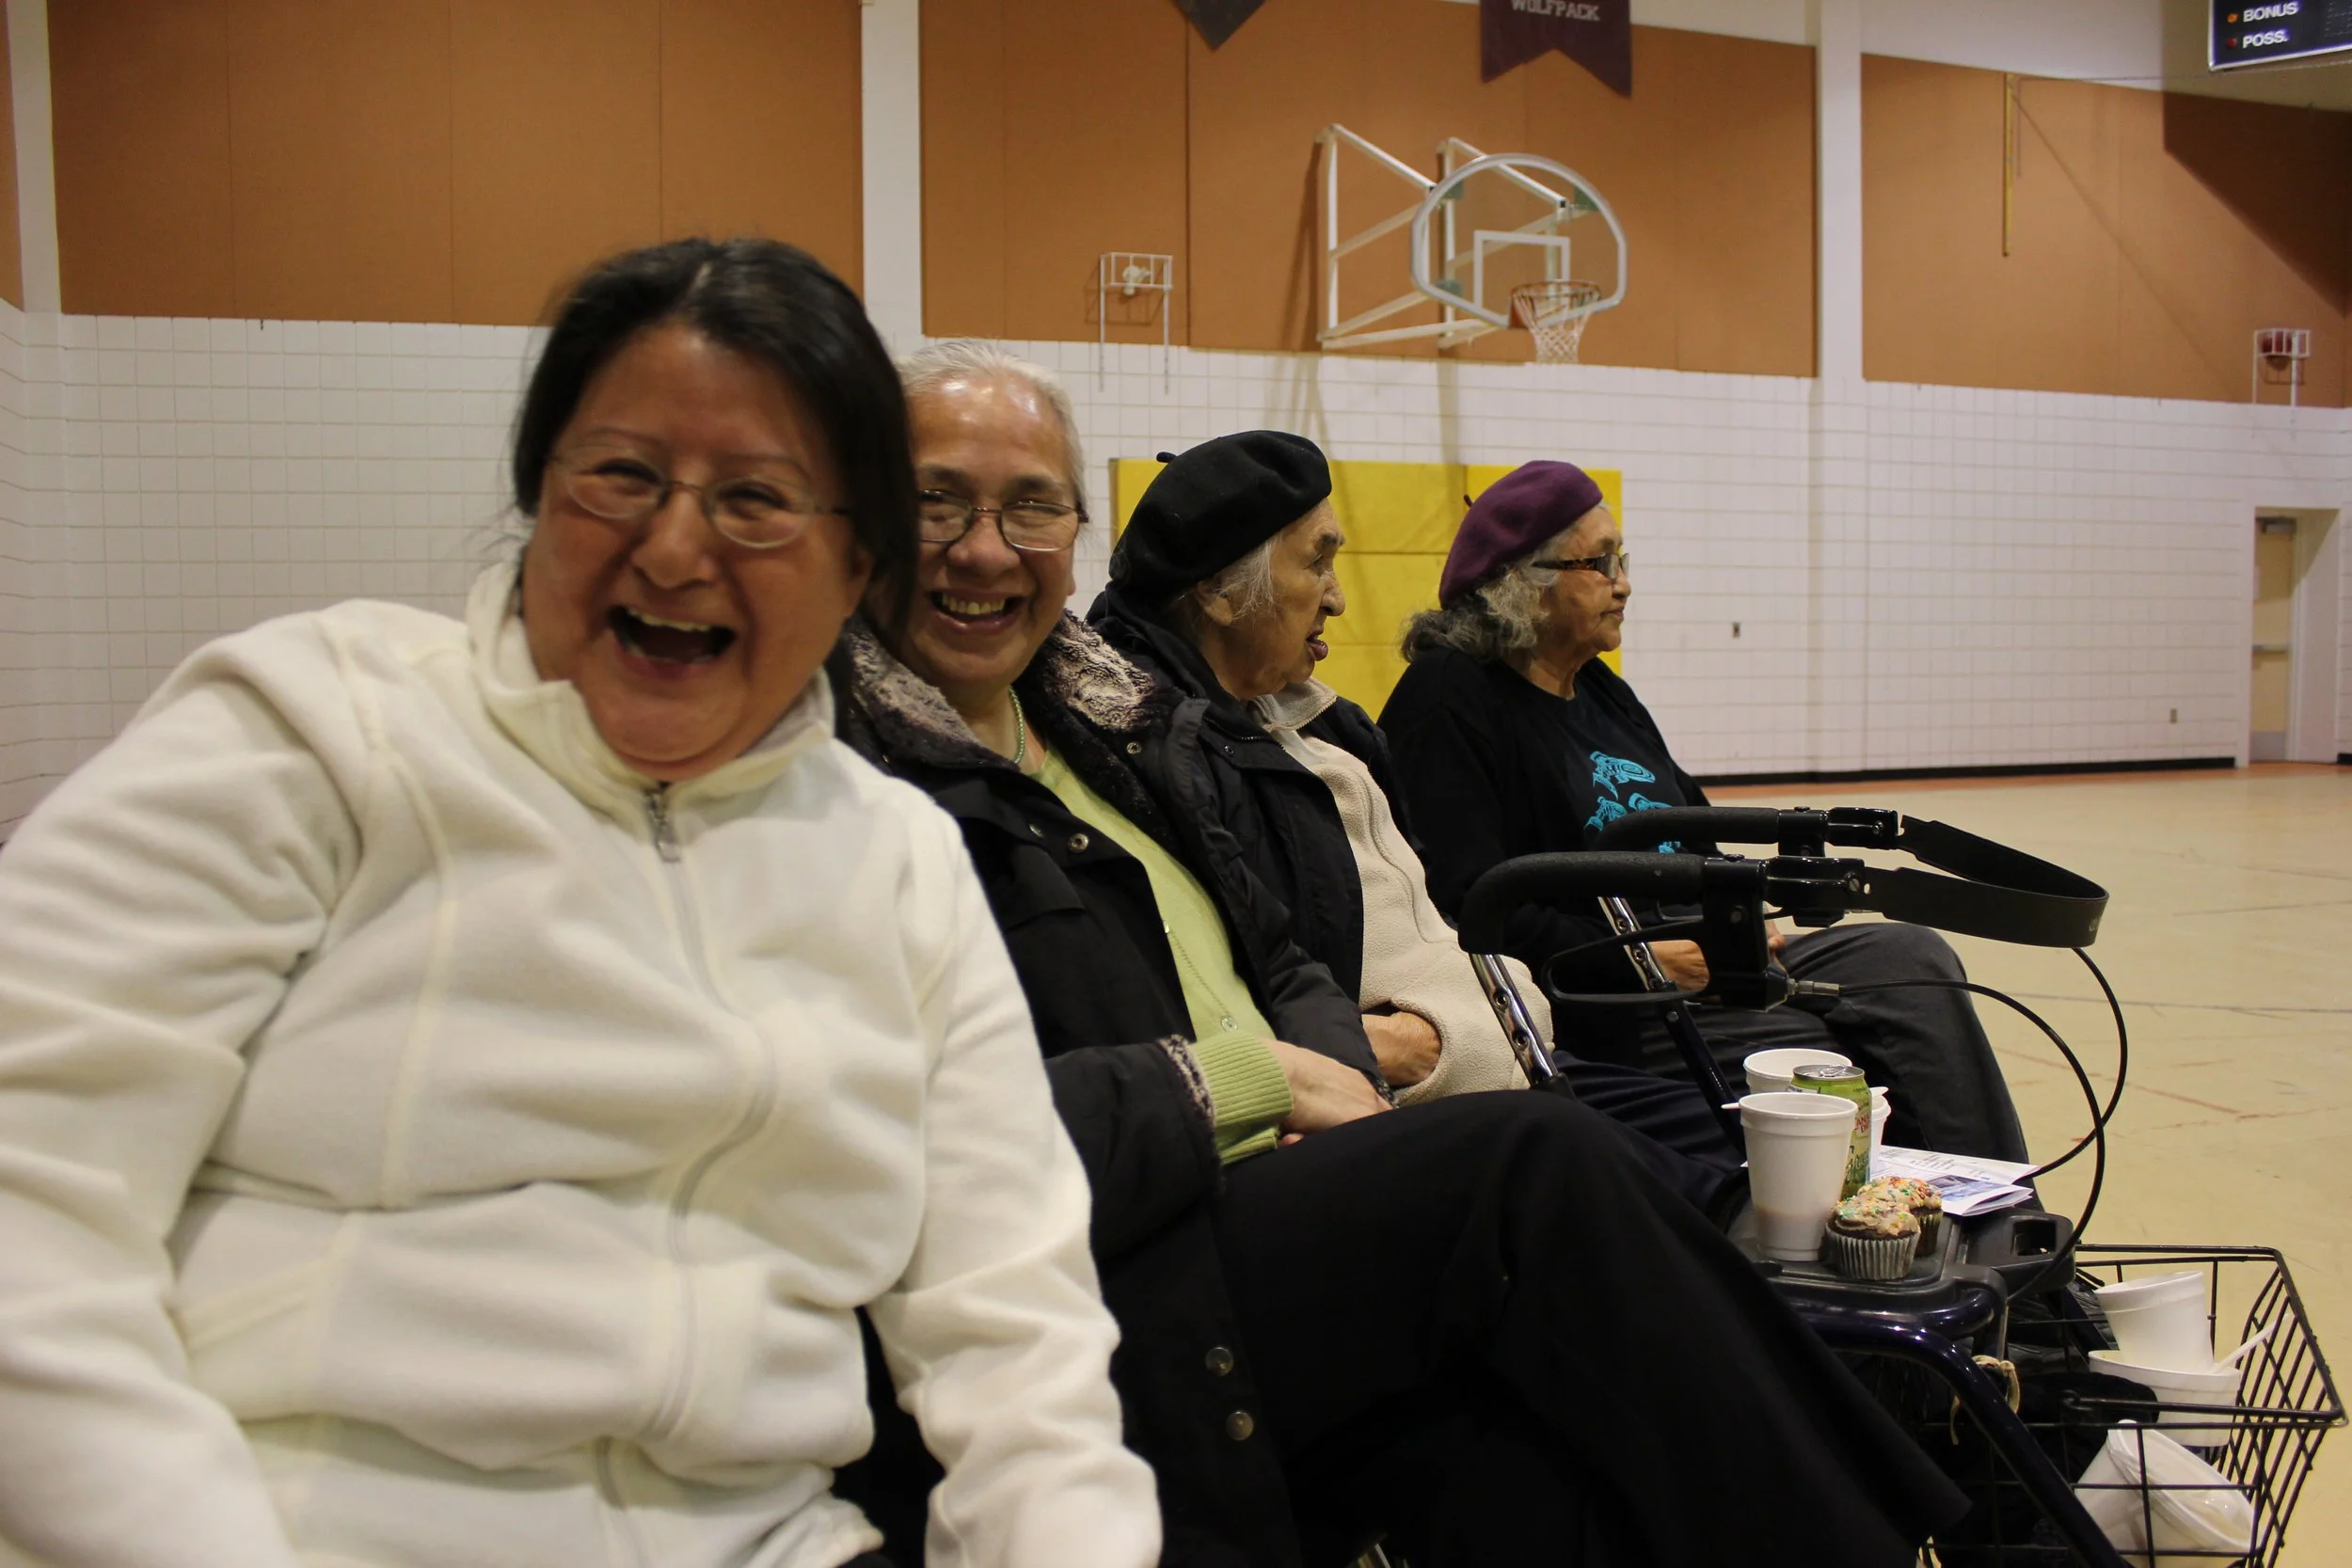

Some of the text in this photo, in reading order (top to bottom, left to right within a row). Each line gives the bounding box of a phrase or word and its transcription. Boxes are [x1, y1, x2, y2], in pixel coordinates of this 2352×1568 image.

[1511, 0, 1600, 22] WOLFPACK
[2243, 1, 2299, 23] BONUS
[2242, 28, 2289, 48] POSS.
